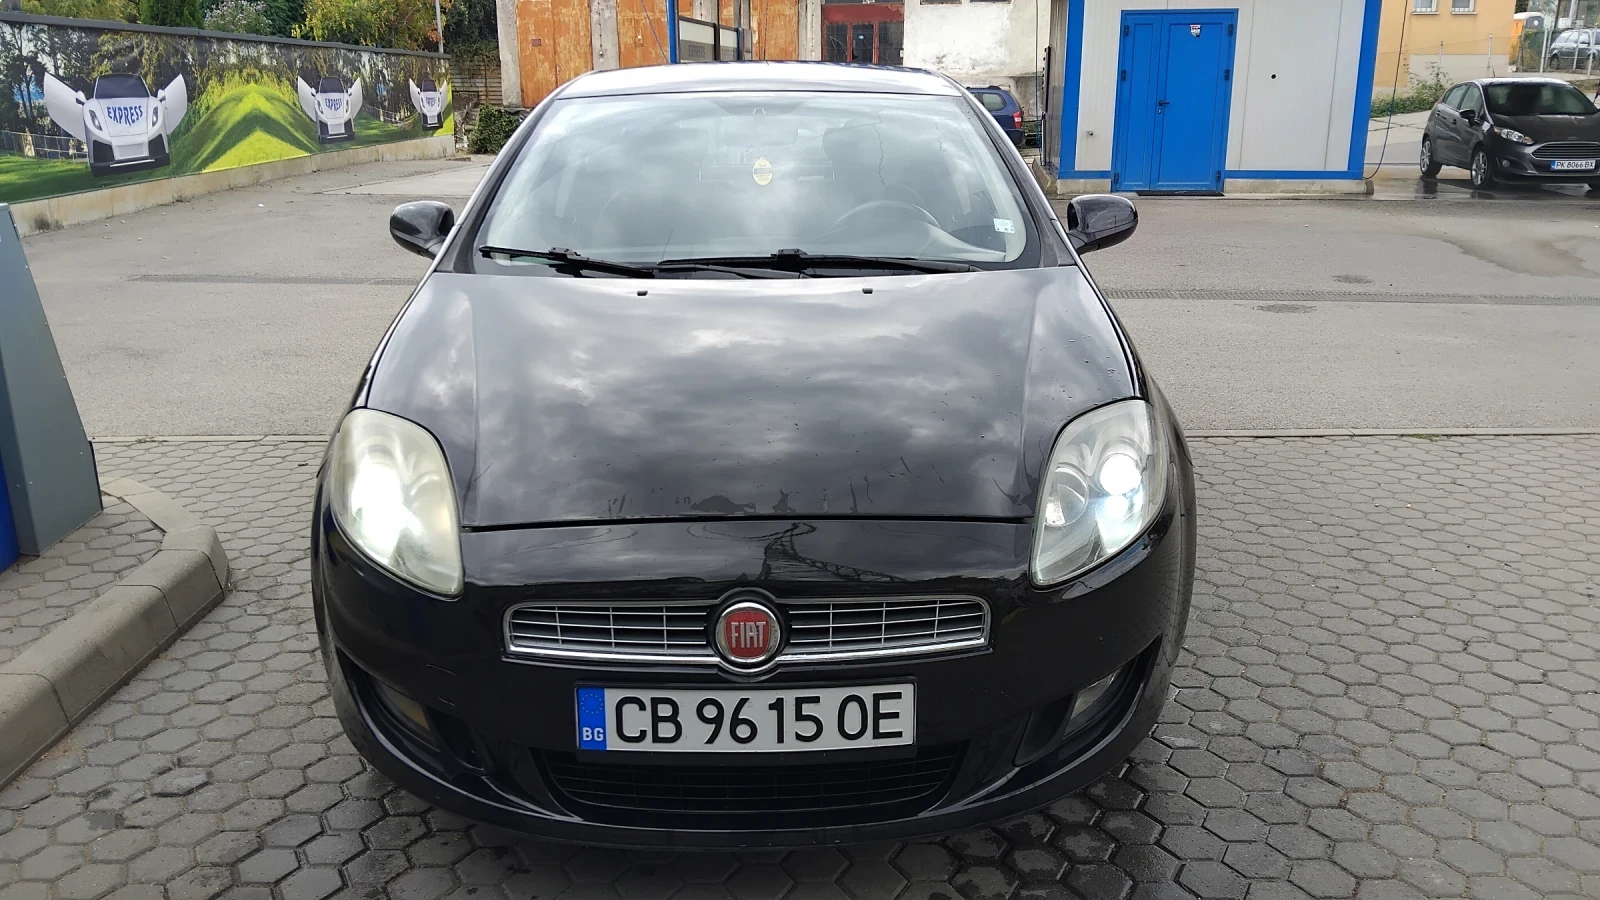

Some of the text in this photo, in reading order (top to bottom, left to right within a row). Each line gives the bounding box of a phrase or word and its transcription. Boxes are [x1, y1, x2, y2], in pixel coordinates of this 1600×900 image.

[106, 105, 144, 127] EXPRESS
[1556, 160, 1594, 169] PK 8066 BX
[731, 622, 766, 648] FIAT
[615, 691, 904, 745] CB 9615 OE
[582, 727, 605, 742] BG
